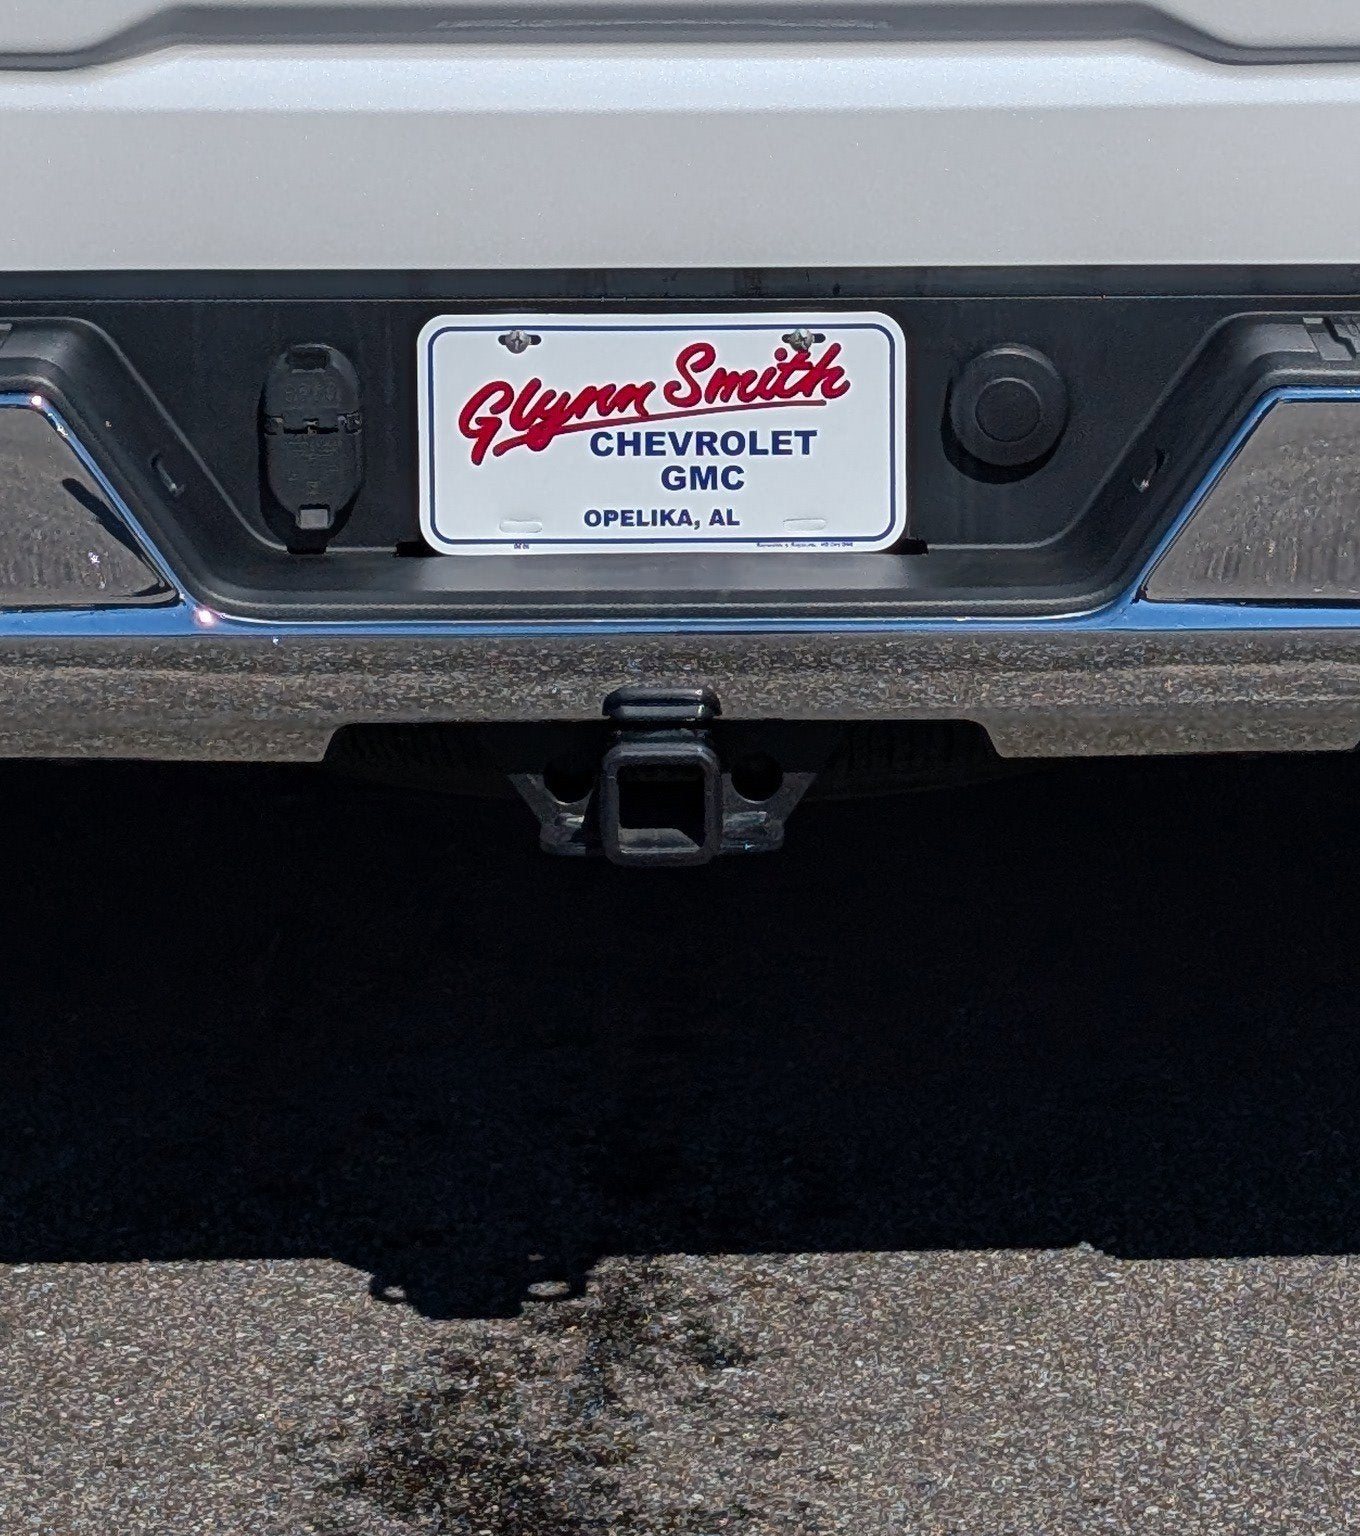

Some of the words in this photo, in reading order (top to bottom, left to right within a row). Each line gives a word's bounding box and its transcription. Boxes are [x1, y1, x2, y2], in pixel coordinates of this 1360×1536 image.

[458, 377, 655, 465] Glynn
[663, 342, 852, 409] Smith
[589, 429, 818, 457] CHEVROLET
[660, 465, 745, 491] GMC
[583, 508, 701, 530] OPELIKA,
[708, 508, 741, 528] AL
